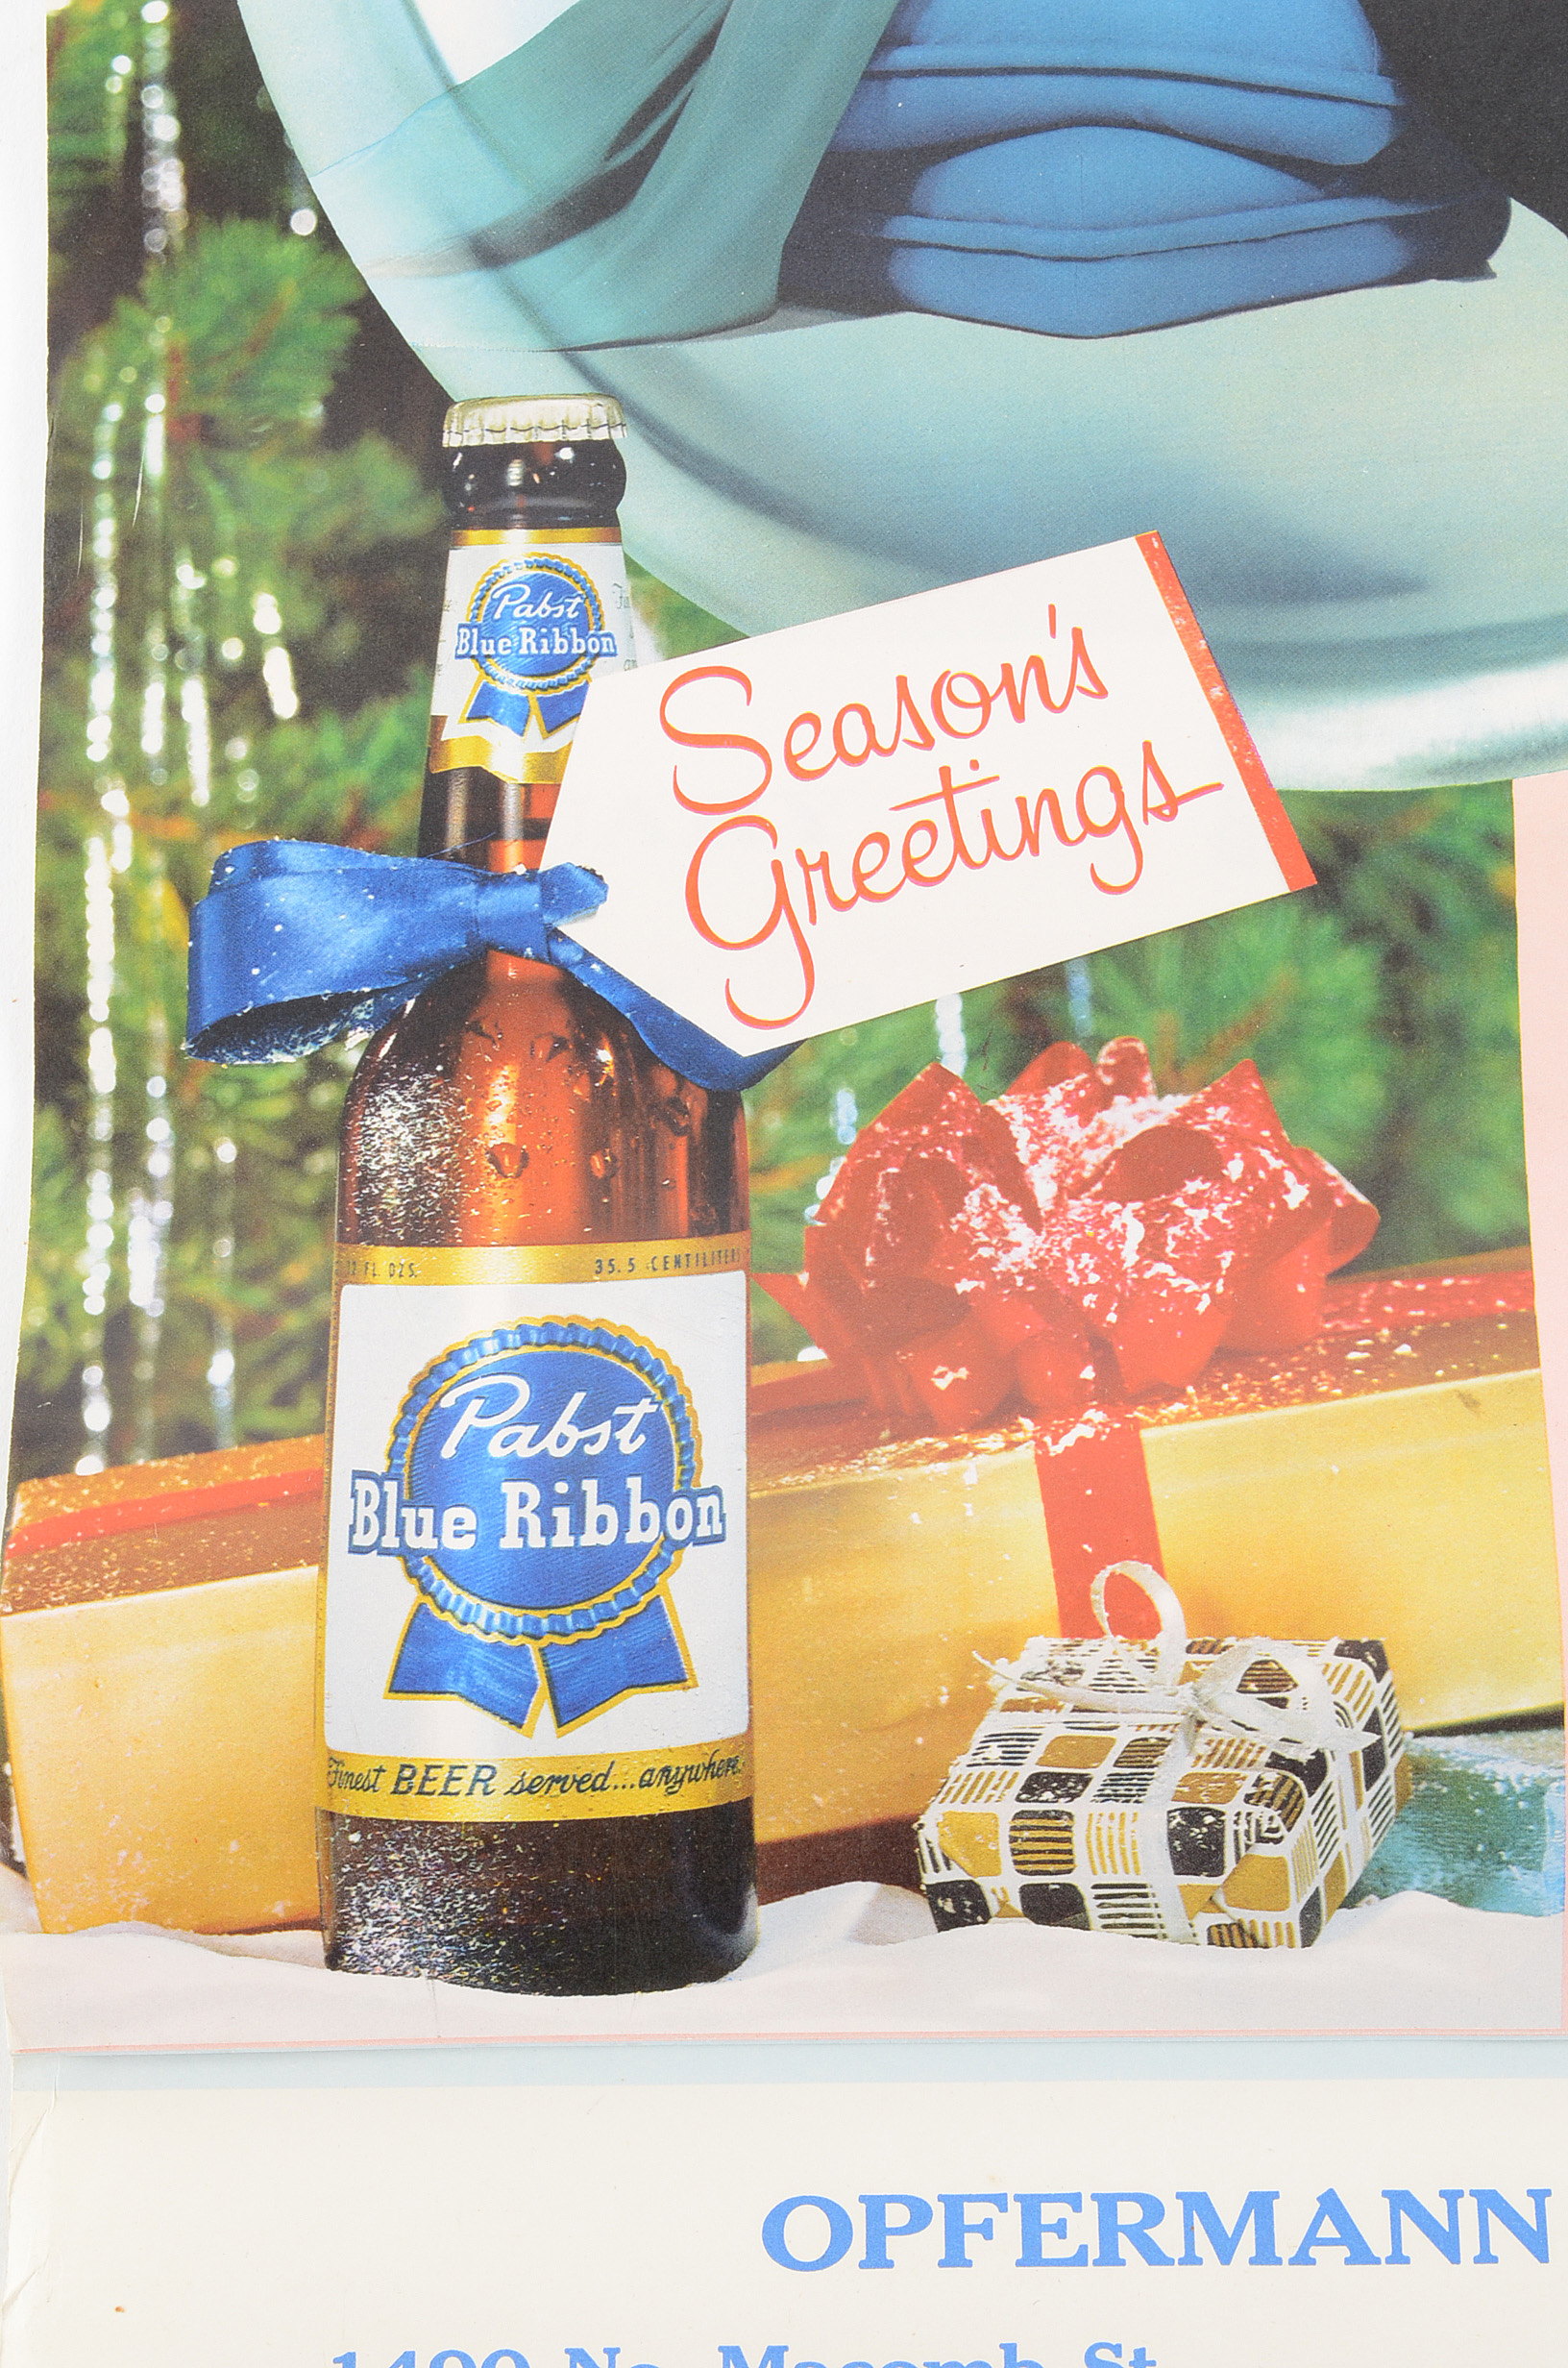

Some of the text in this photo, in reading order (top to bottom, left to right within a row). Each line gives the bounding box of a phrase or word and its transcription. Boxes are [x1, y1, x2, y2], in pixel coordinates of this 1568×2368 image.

[491, 582, 588, 620] Pabst
[456, 627, 512, 656] Blue
[519, 627, 616, 656] Ribbon
[659, 604, 1110, 815] Season's
[684, 740, 1224, 1029] Greetings
[594, 1256, 636, 1275] 35.5
[439, 1372, 660, 1460] Pabst
[352, 1476, 724, 1551] Blue Ribbon
[327, 1756, 387, 1793] Finest
[389, 1763, 497, 1795] BEER
[761, 2187, 1553, 2273] OPFERMANN
